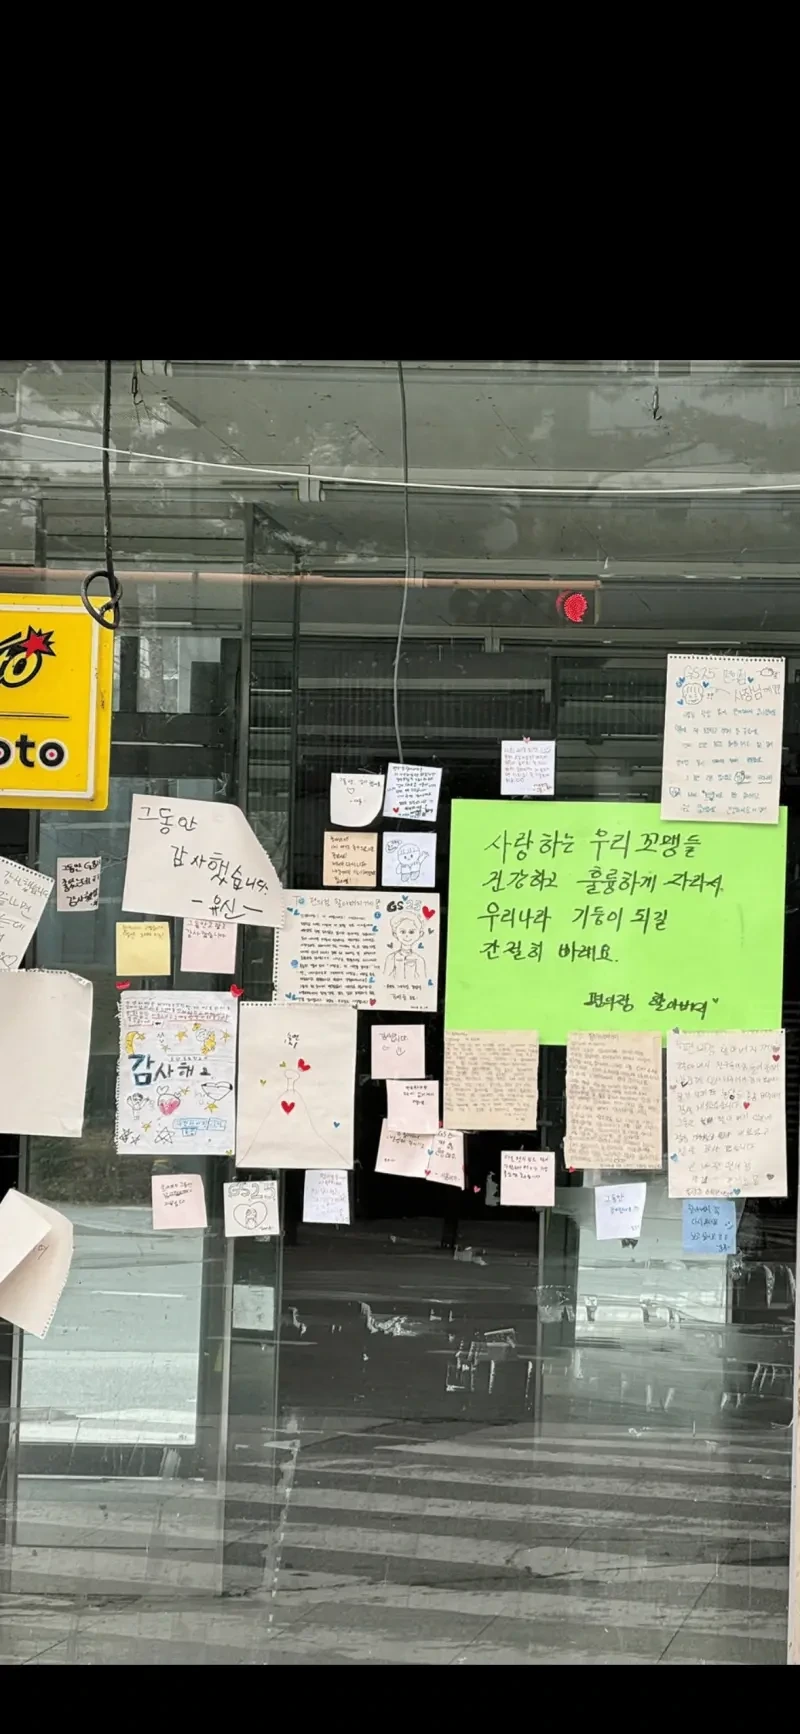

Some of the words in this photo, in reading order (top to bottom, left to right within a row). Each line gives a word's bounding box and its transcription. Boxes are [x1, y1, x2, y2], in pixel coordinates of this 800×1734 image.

[138, 806, 198, 835] 그동안
[589, 828, 632, 861] 우리
[482, 868, 559, 892] 건강하고
[477, 901, 552, 932] 우리나라
